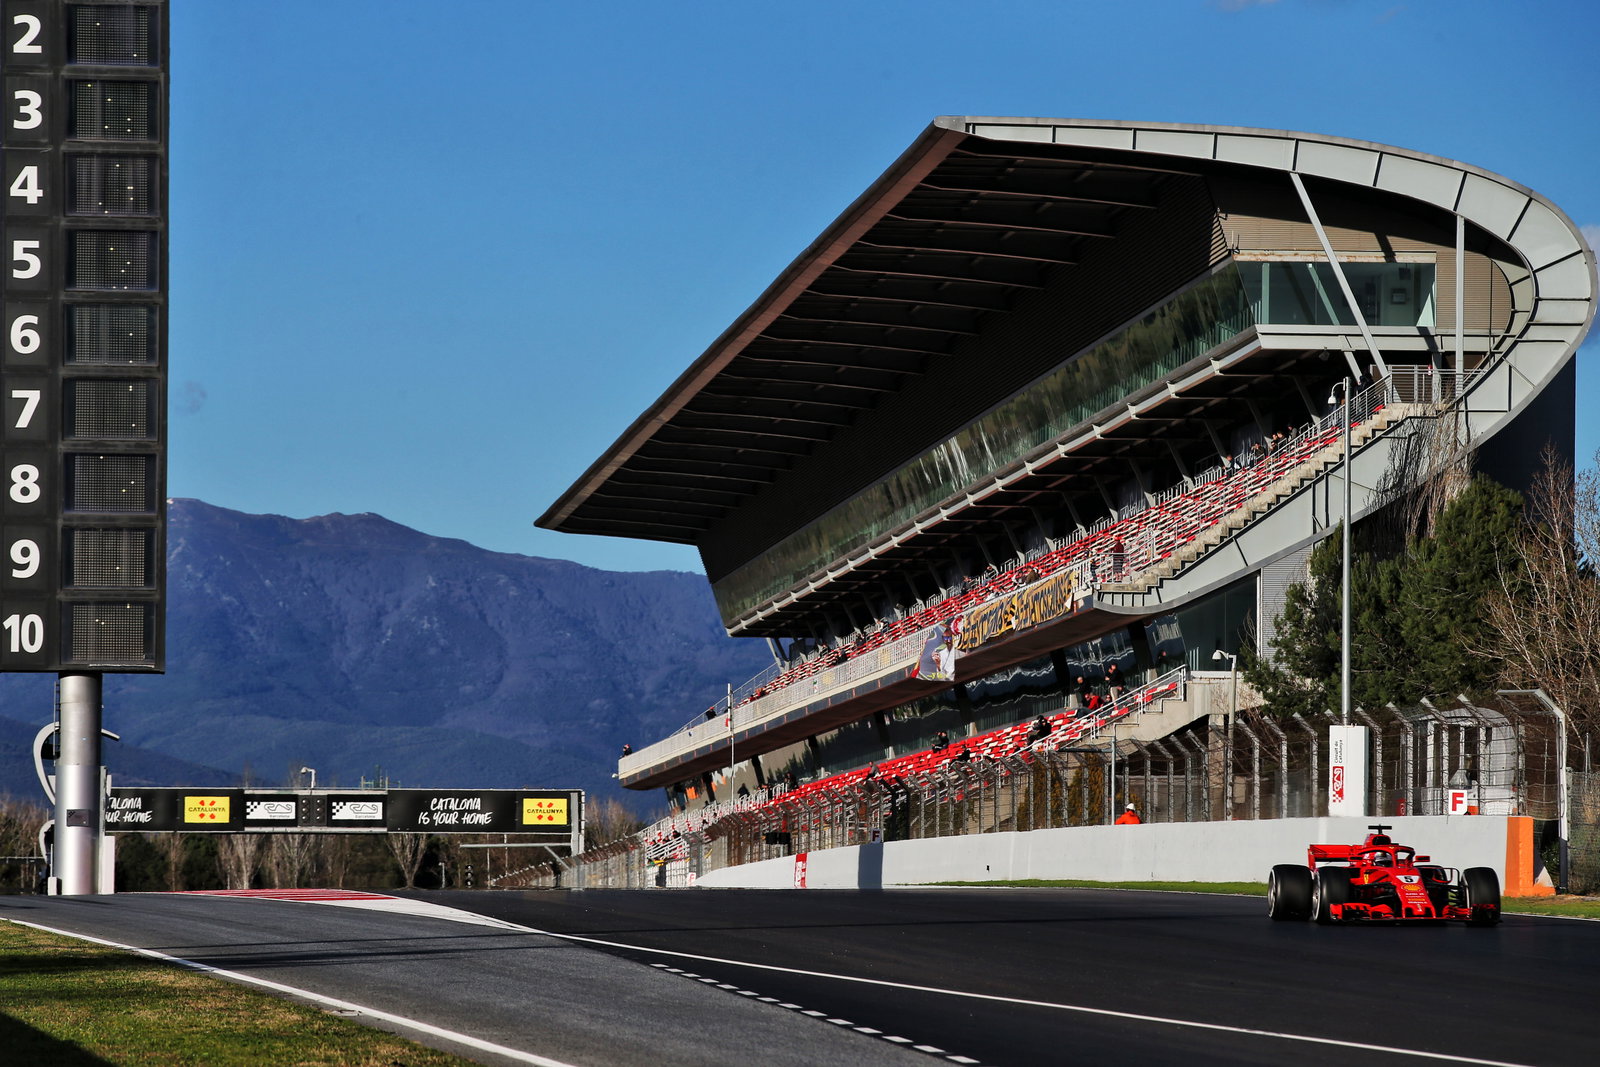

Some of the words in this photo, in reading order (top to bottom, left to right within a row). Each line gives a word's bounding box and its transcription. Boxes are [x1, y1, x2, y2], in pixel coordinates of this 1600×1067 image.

[12, 14, 43, 54] 2
[13, 89, 43, 130] 3
[9, 165, 44, 204] 4
[12, 240, 42, 279] 5
[9, 314, 41, 354] 6
[11, 389, 41, 428] 7
[9, 463, 41, 503] 8
[9, 539, 41, 579] 9
[2, 613, 44, 653] 10
[122, 810, 153, 824] HOME
[418, 811, 430, 825] IS
[432, 811, 459, 826] YOUR
[461, 811, 493, 825] HOME
[430, 797, 481, 811] CATALONIA
[1451, 792, 1464, 812] F
[872, 830, 881, 842] F
[1403, 875, 1414, 883] 5
